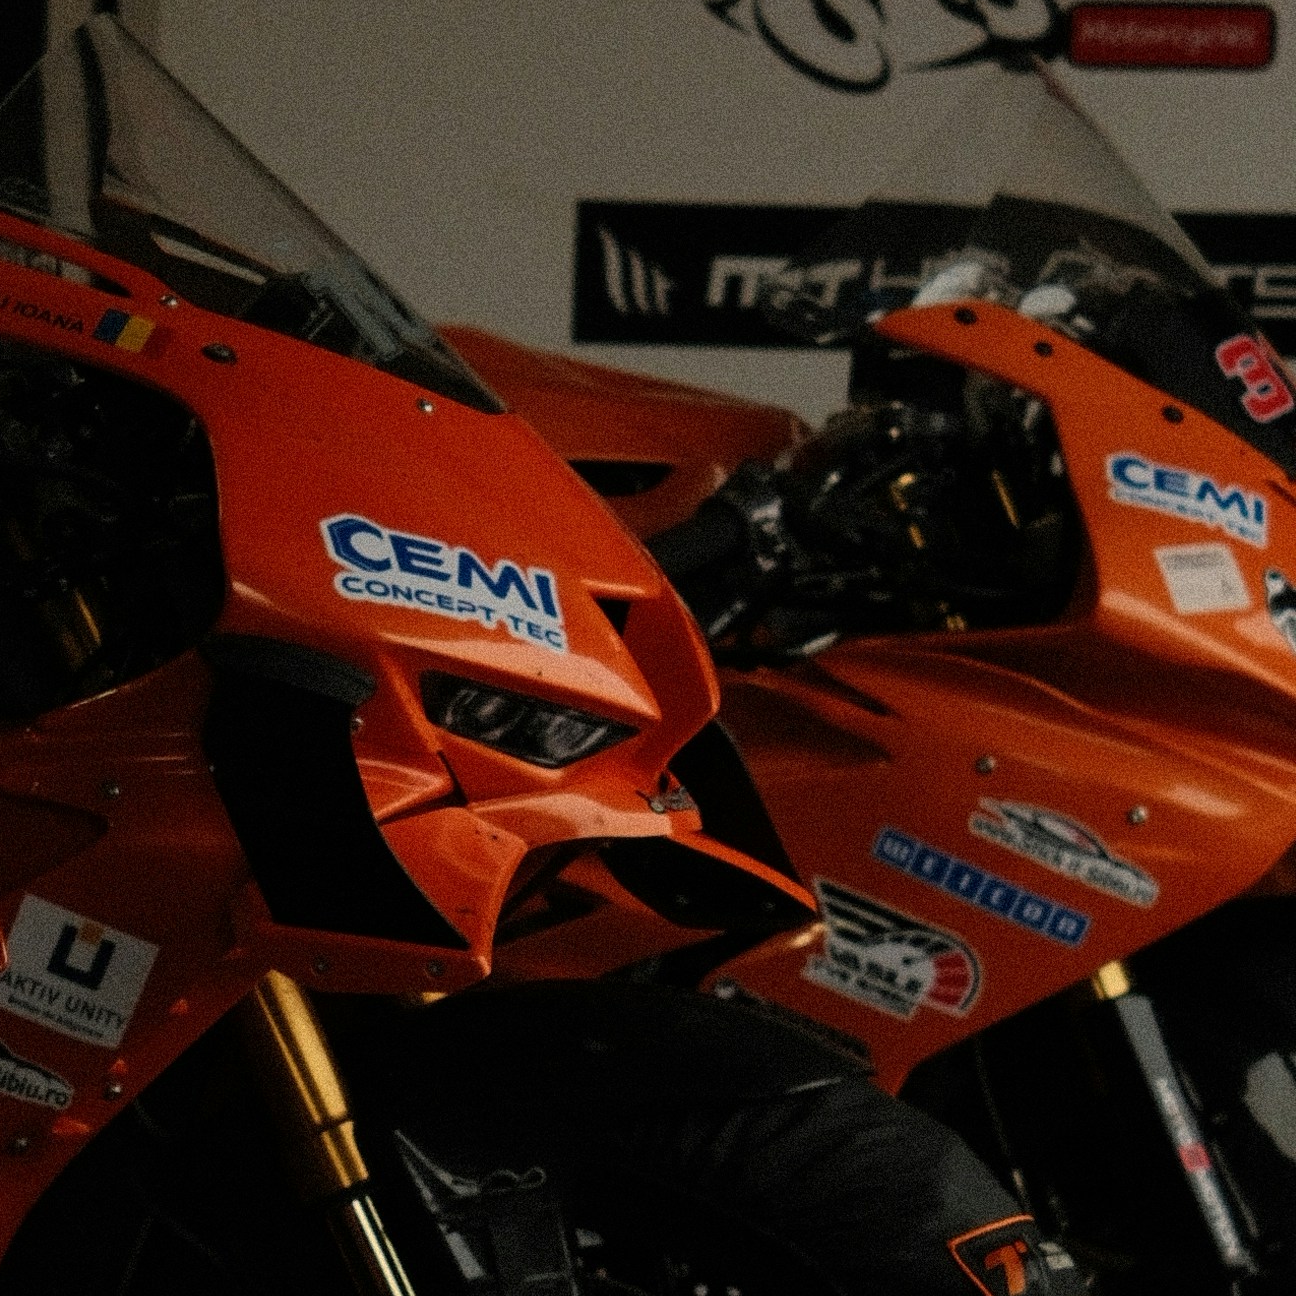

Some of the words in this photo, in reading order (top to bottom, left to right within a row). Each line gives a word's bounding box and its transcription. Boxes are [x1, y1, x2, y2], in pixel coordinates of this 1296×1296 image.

[12, 301, 85, 335] IOANA
[1112, 457, 1263, 524] CEMI
[327, 517, 559, 619] CEMI
[341, 576, 497, 622] CONCEPT
[507, 613, 565, 650] TEC
[64, 995, 127, 1029] UNITY
